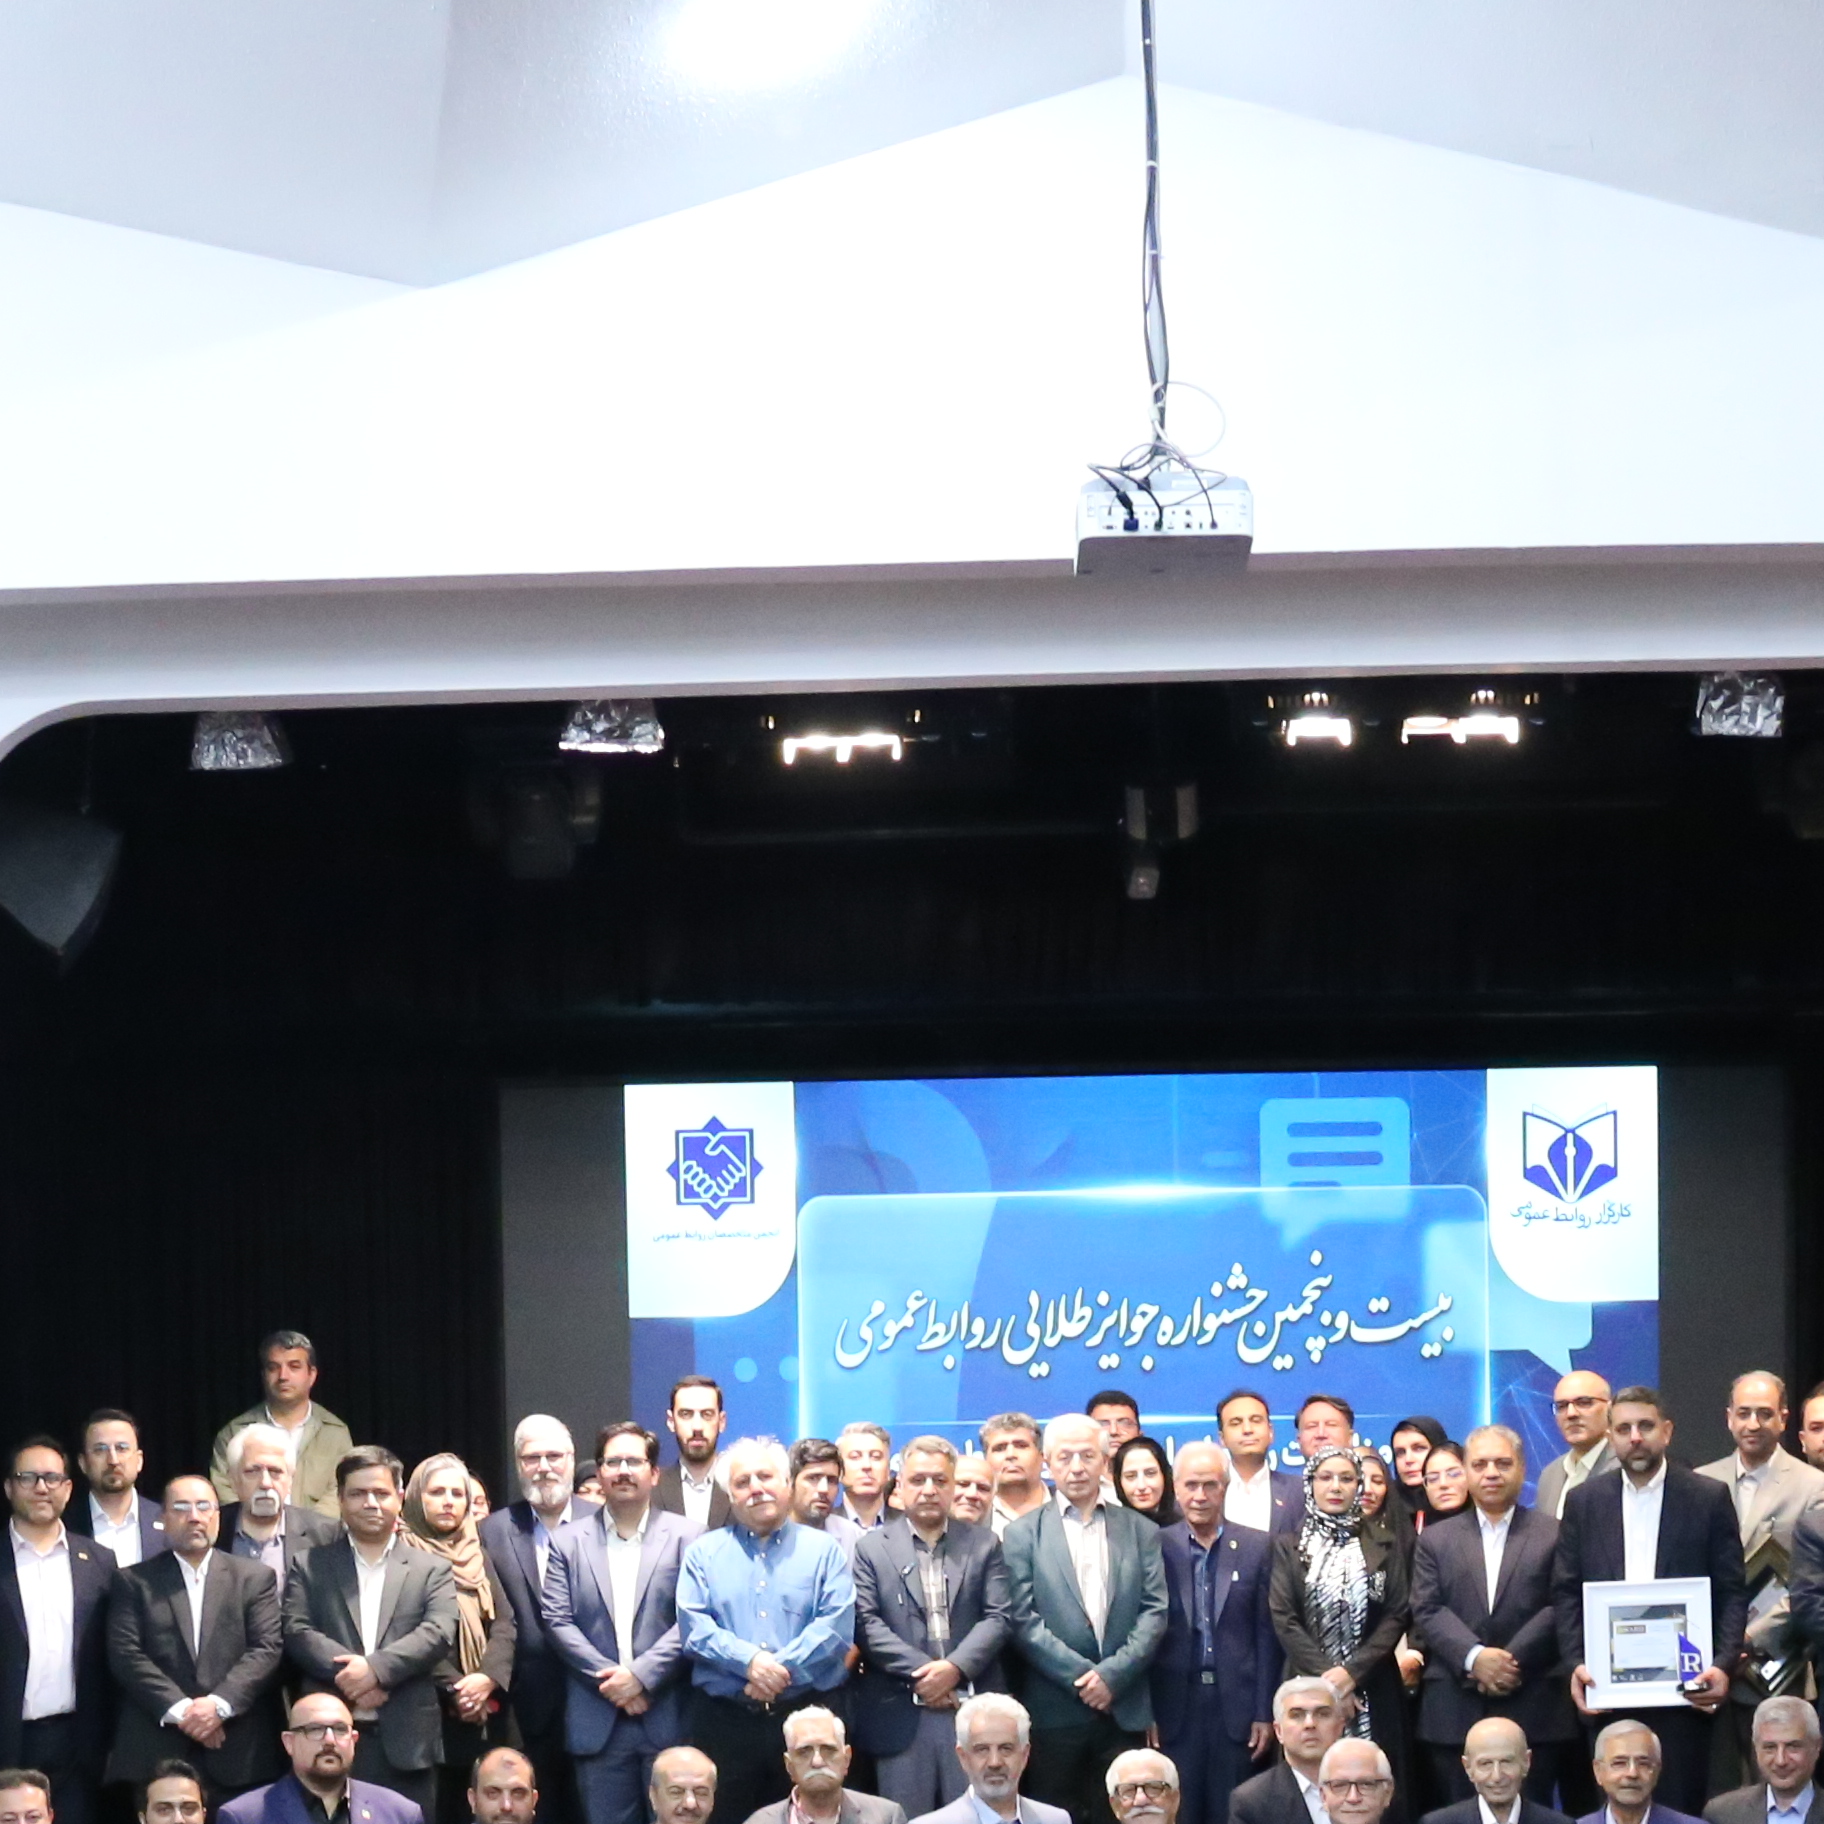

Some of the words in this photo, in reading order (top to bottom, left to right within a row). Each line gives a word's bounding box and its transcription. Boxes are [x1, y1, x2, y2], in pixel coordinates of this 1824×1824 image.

[1553, 1207, 1592, 1229] روابط
[834, 1289, 928, 1368] عمومی
[916, 1298, 1003, 1371] روابط
[1002, 1286, 1094, 1378] طلایی
[1084, 1290, 1160, 1371] جوایز
[1155, 1261, 1269, 1346] جشنواره
[1236, 1249, 1334, 1371] پنجمین
[1350, 1291, 1455, 1358] بیست
[1681, 1652, 1702, 1673] R
